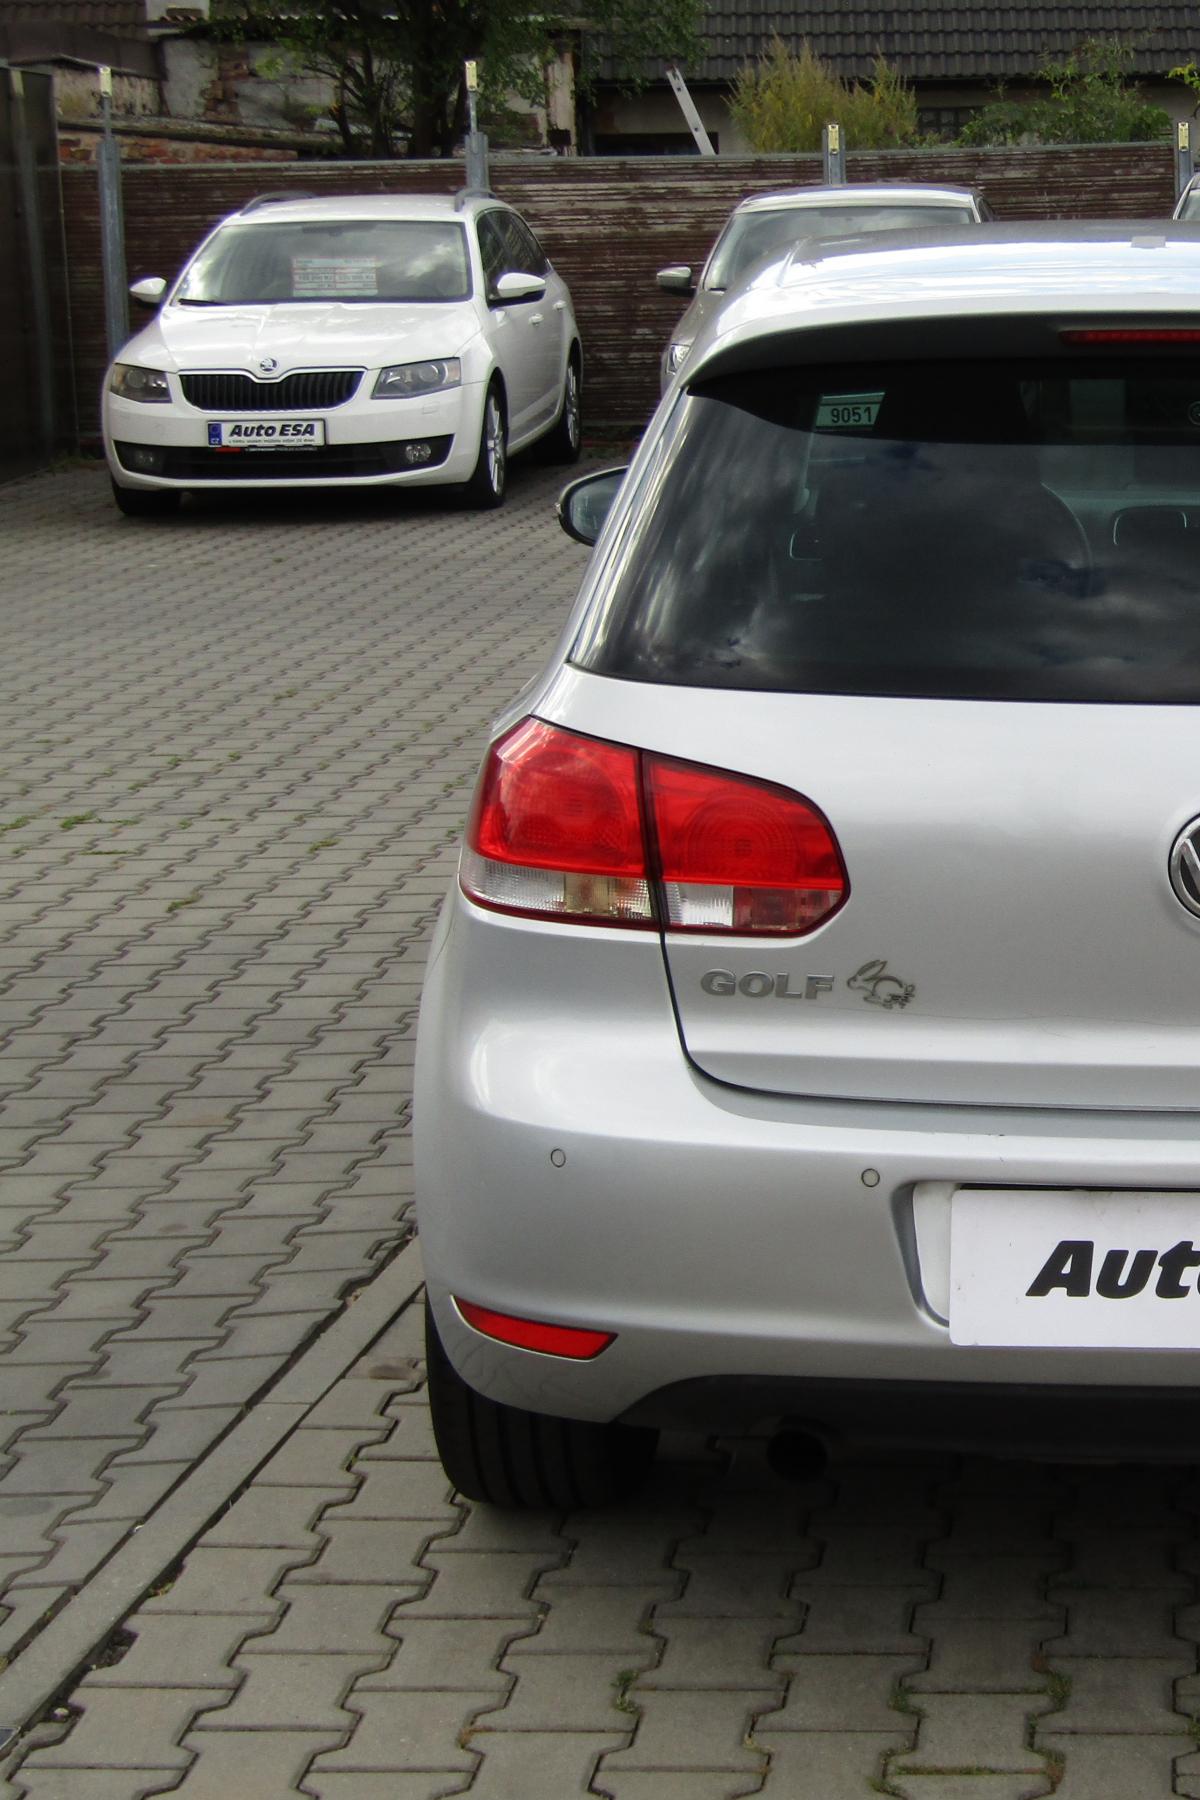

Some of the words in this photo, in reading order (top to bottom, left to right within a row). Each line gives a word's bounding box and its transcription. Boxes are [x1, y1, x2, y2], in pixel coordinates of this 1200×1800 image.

[831, 406, 872, 423] 9051
[229, 424, 276, 437] Auto
[278, 423, 315, 437] ESA
[700, 968, 834, 1000] GOLF
